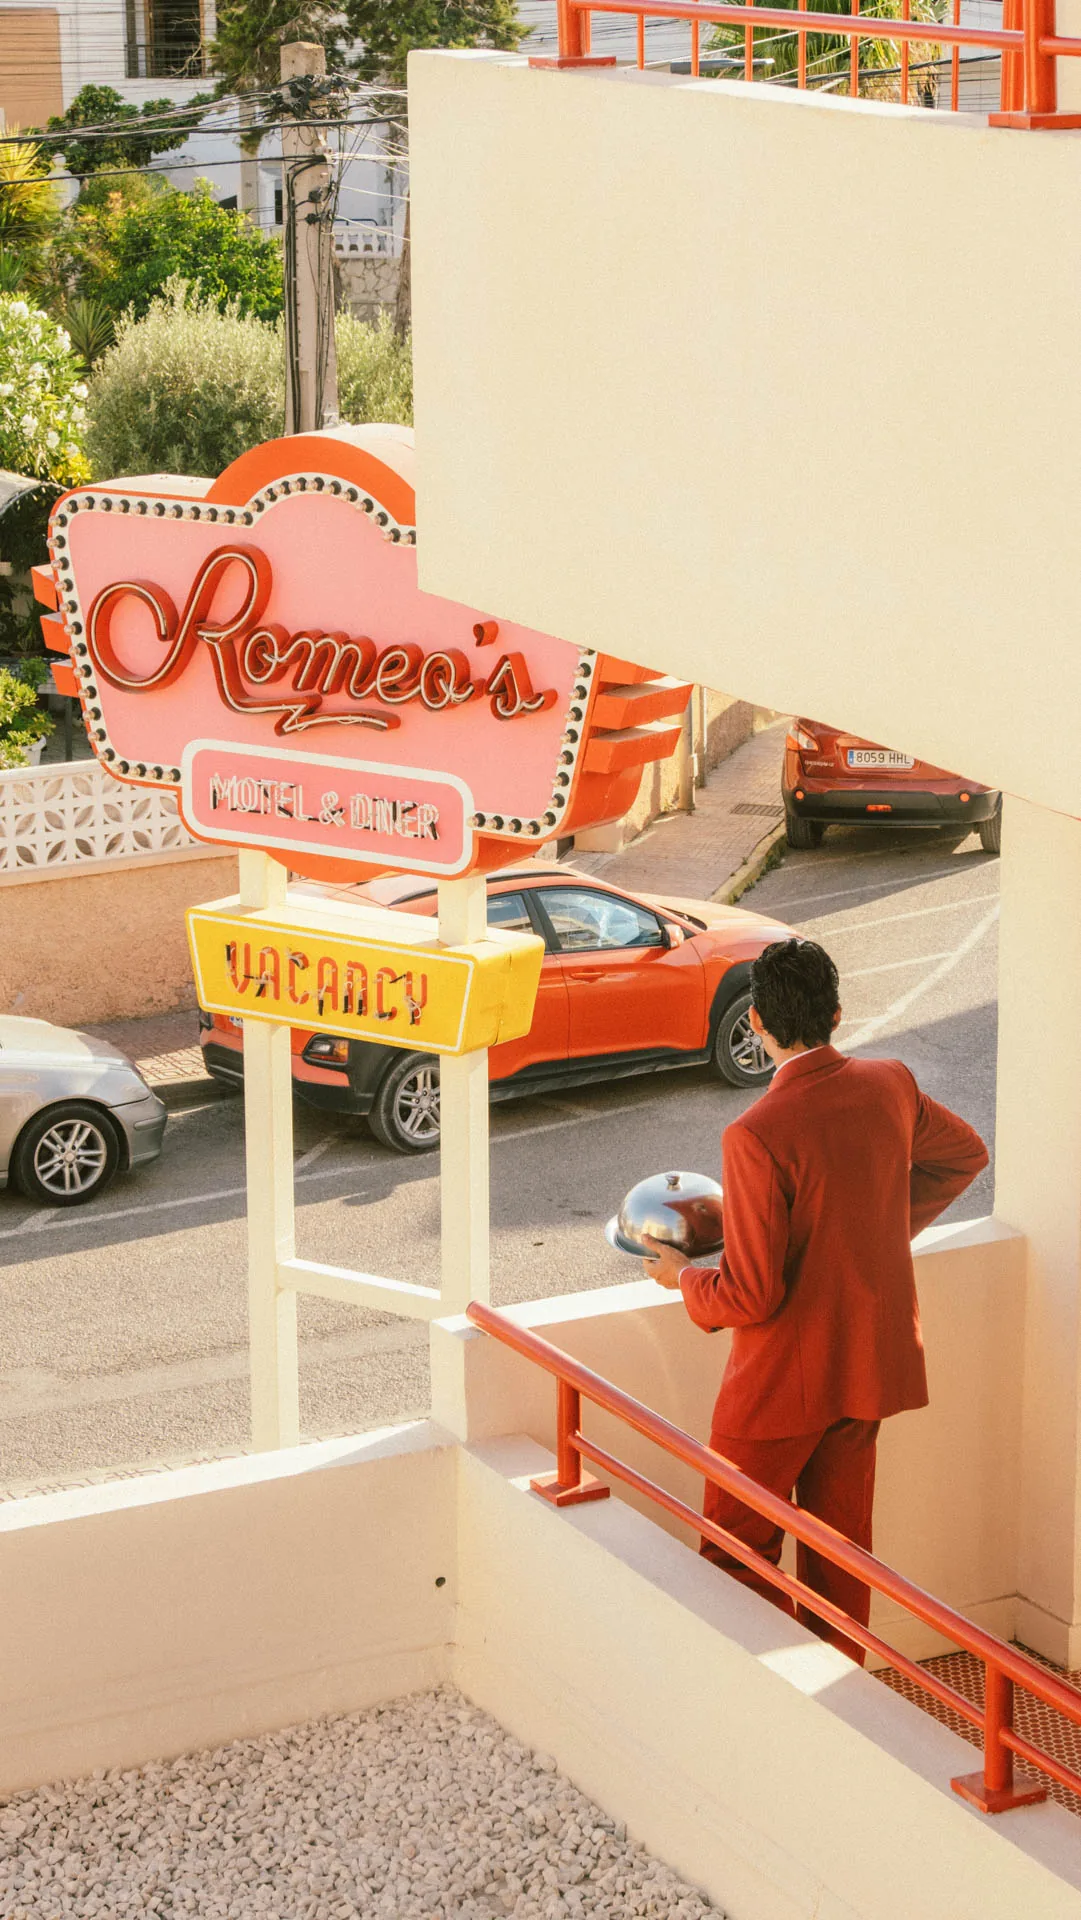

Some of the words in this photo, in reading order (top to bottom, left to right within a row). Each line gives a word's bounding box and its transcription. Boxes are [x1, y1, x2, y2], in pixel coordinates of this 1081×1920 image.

[86, 544, 558, 736] Romeo's
[856, 752, 885, 763] 8059
[889, 752, 911, 764] HHL
[209, 772, 311, 822] MOTEL
[318, 790, 346, 828] &
[350, 793, 441, 840] DINER
[225, 940, 428, 1026] VACANCY
